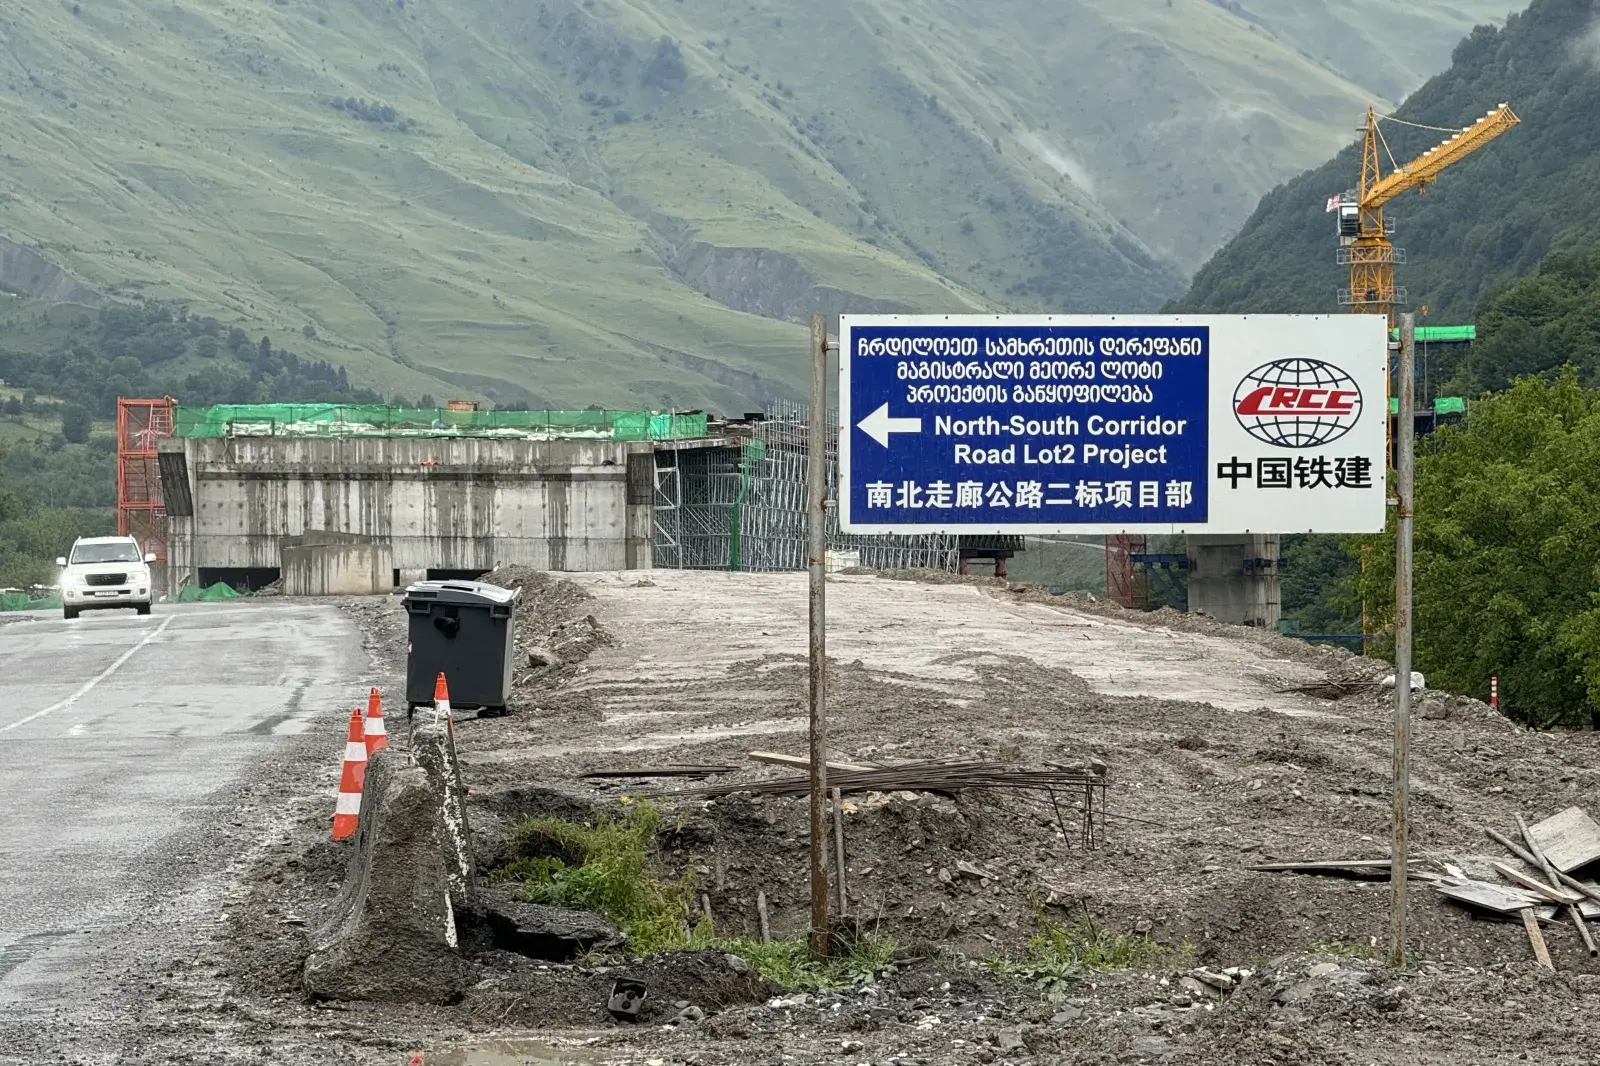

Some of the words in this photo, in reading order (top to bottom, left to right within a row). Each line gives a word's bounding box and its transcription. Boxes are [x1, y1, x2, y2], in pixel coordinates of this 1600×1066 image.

[858, 337, 977, 356] ჩრდილოეთ
[986, 337, 1095, 356] სამხრეთის
[1100, 337, 1202, 356] დერეფანი
[897, 361, 1025, 379] მაგისტრალი
[1030, 361, 1096, 379] მეორე
[1101, 361, 1163, 379] ლოტი
[906, 384, 1008, 403] პროექტის
[1013, 384, 1153, 403] განყოფილება
[1236, 386, 1358, 416] CRCC
[935, 415, 1079, 436] North-South
[1087, 415, 1187, 436] Corridor
[954, 444, 1016, 465] Road
[1023, 444, 1075, 465] Lot2
[1083, 444, 1167, 469] Project
[1217, 456, 1373, 490] 中国铁建
[865, 479, 1193, 509] 南北走廊公路二标项目部
